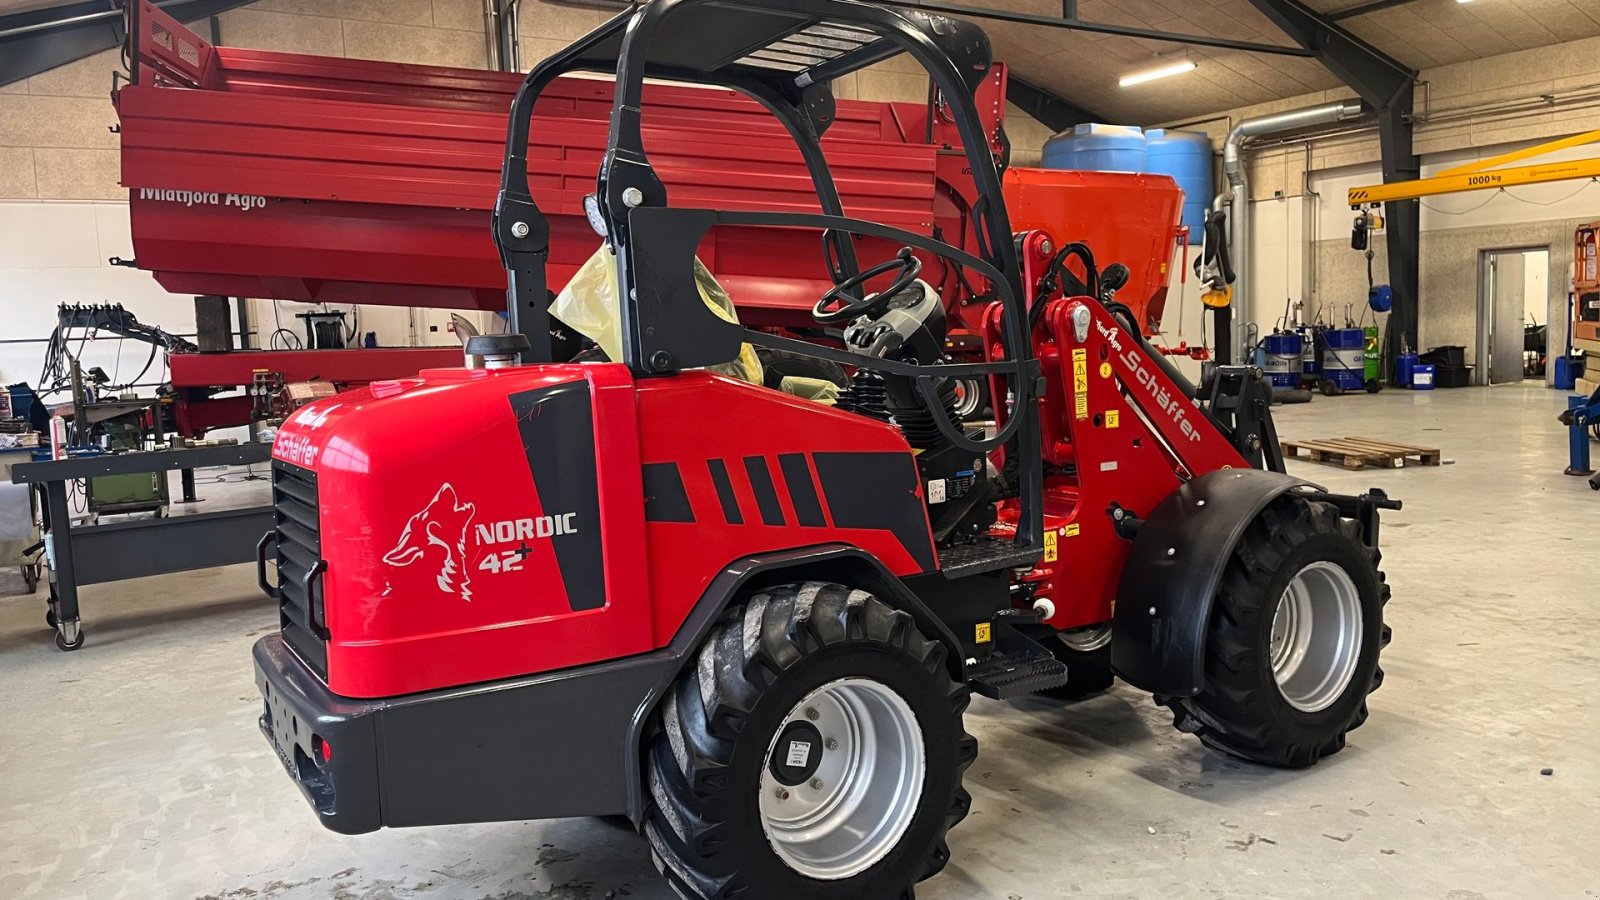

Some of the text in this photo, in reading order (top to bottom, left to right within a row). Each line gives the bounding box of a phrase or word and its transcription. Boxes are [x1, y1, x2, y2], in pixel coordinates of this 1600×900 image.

[1468, 176, 1489, 185] 1000
[225, 193, 266, 211] Agro
[1119, 350, 1201, 442] Schäffer
[475, 512, 578, 546] NORDIC
